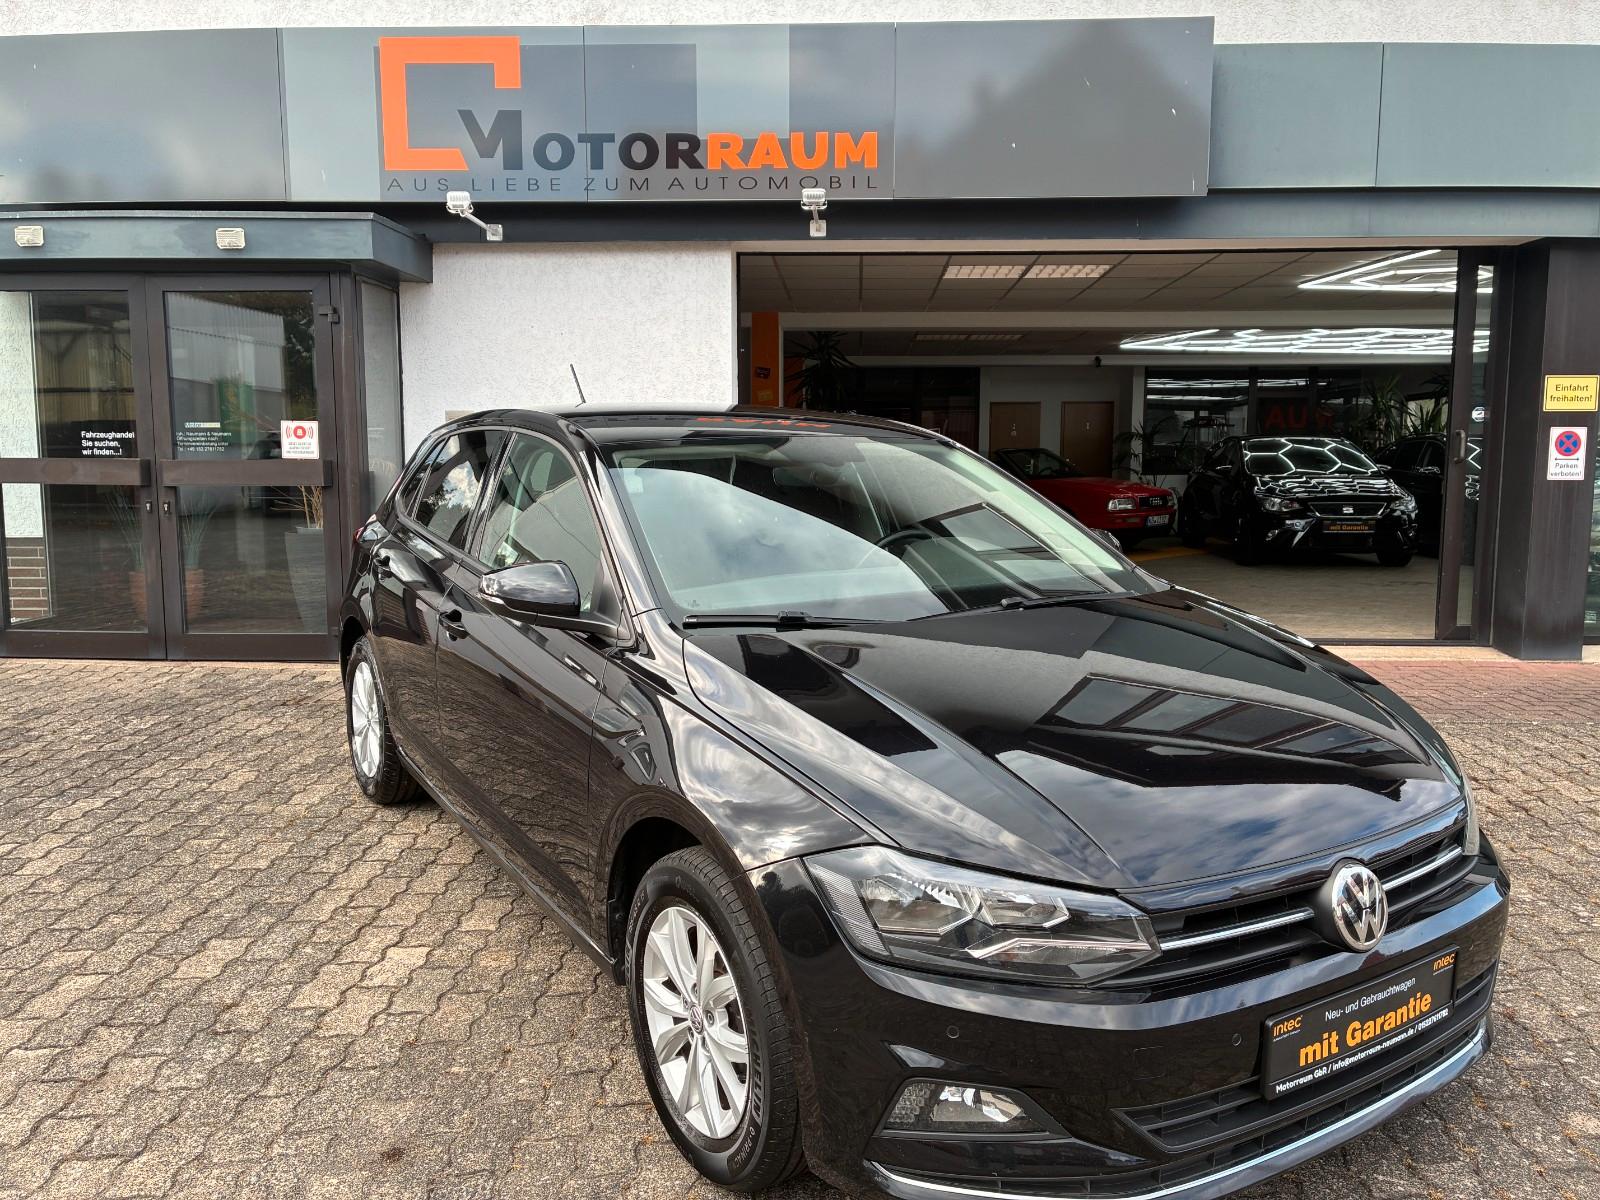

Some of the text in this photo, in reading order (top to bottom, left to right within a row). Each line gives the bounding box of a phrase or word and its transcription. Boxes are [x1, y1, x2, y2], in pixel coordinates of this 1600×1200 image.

[387, 175, 878, 192] AUS LIEBE ZUM AUTOMOBIL
[1555, 384, 1589, 392] Einfahrt
[1549, 394, 1593, 402] freihalten!
[81, 430, 135, 439] Fahrzeughandel
[81, 439, 121, 447] Sie suchen,
[1325, 977, 1416, 1021] Neu- und Gebrauchtwagen
[1299, 992, 1432, 1067] mit Garantie
[1275, 1072, 1314, 1094] Motorraum
[1313, 1066, 1328, 1079] GbR
